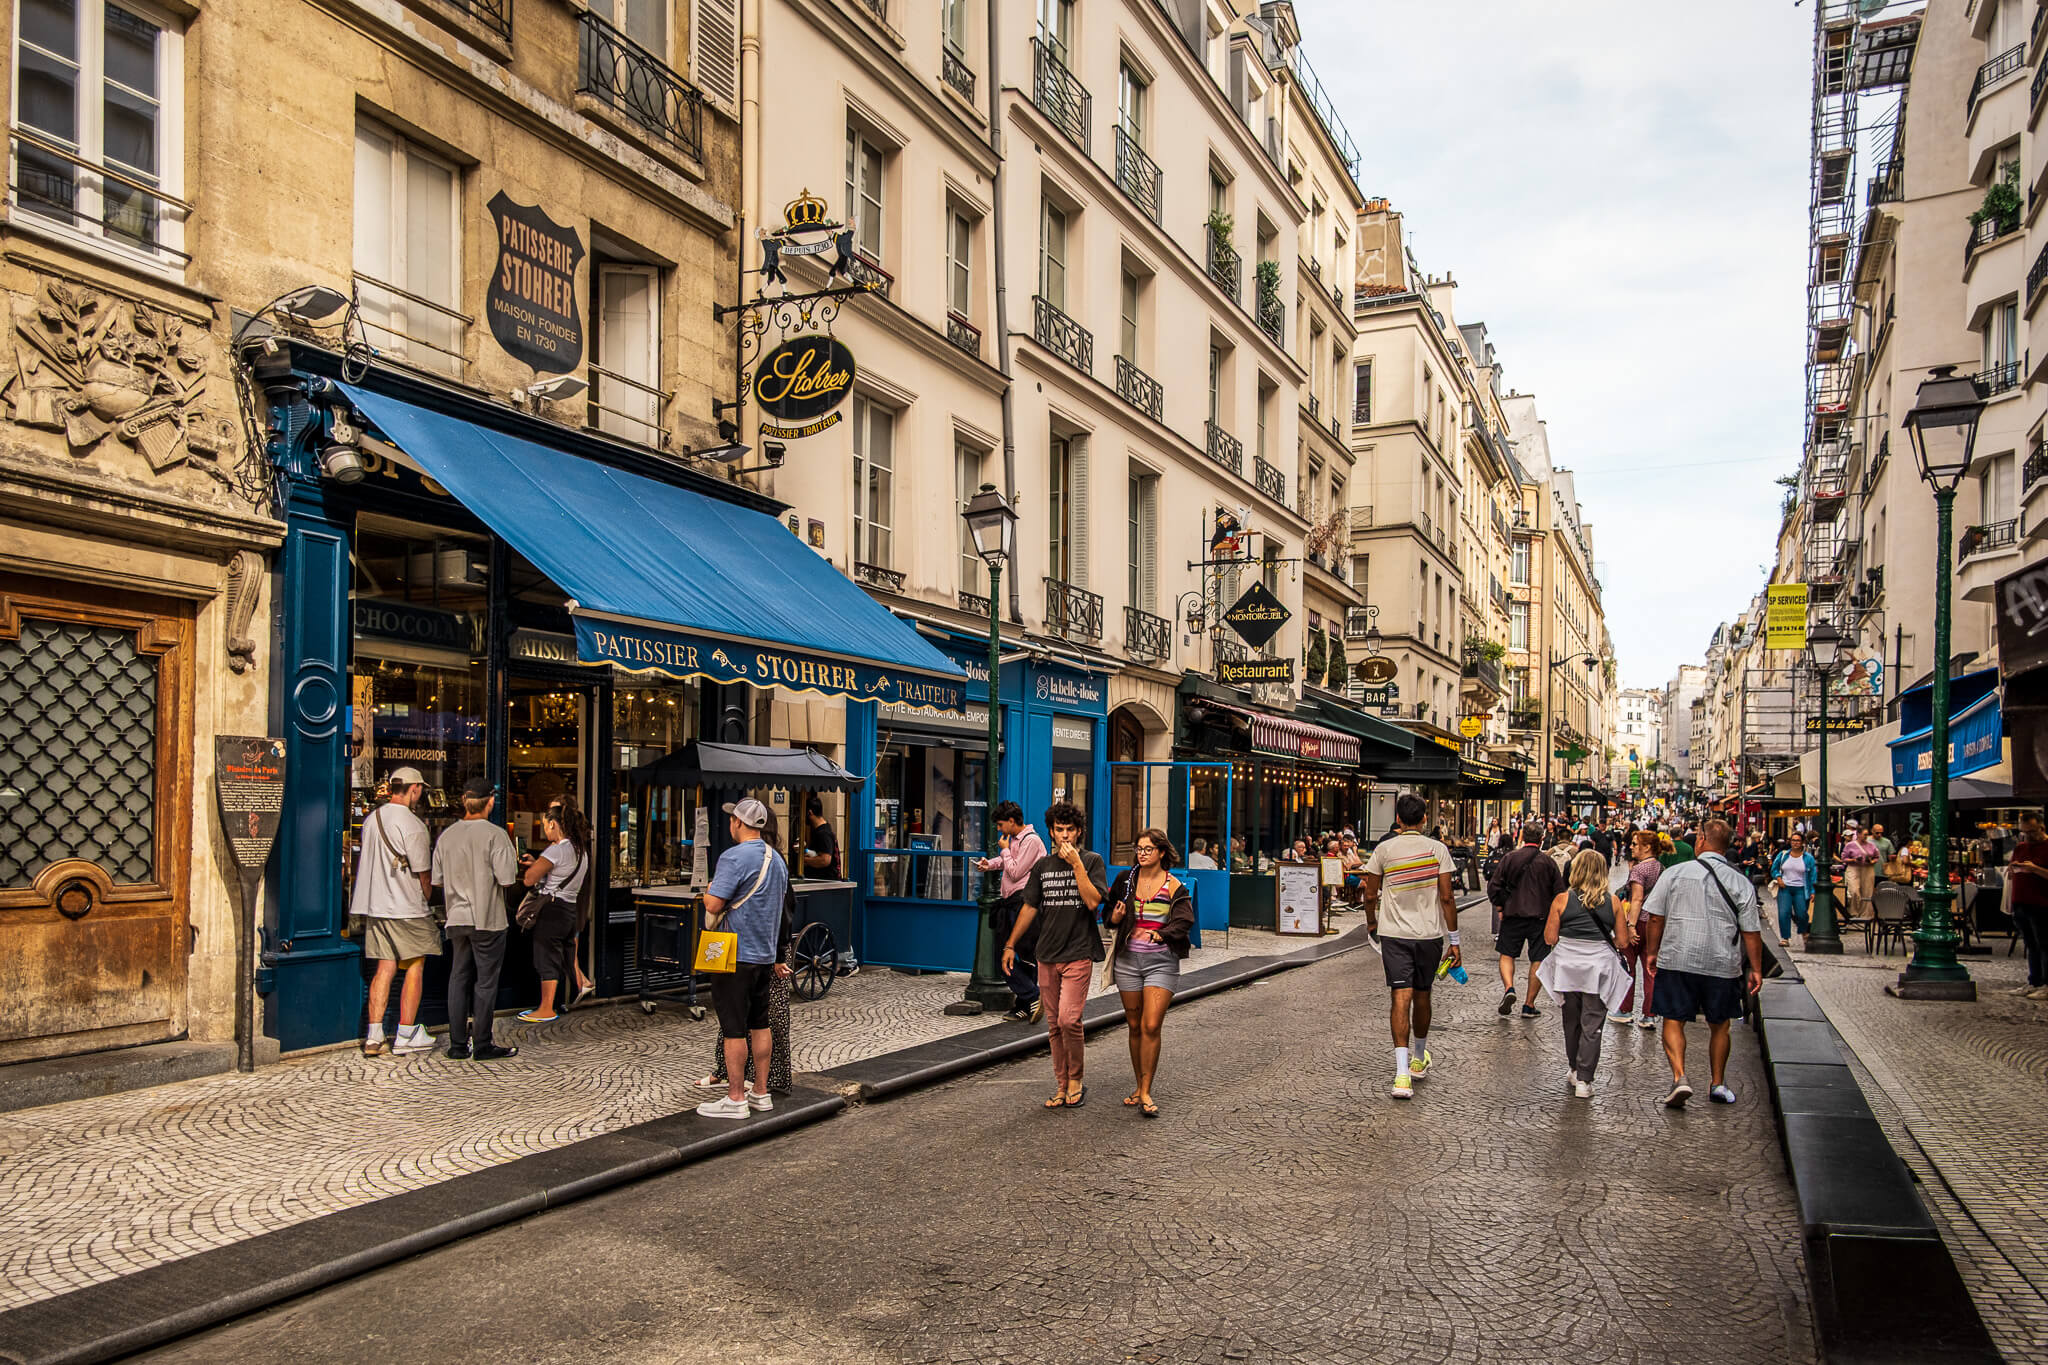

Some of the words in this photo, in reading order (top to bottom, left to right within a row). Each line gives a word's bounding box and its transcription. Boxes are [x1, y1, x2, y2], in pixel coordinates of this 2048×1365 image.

[502, 215, 573, 276] PATISSERIE
[784, 246, 811, 255] DEPUIS
[813, 241, 830, 252] 1730
[502, 252, 572, 319] STOHRER
[494, 298, 535, 326] MAISON
[538, 317, 577, 344] FONDEE
[517, 325, 531, 341] EN
[535, 333, 556, 352] 1730
[757, 348, 850, 402] Stohrer
[761, 424, 799, 440] PATISSIER
[803, 415, 838, 437] TRAITEUR
[1777, 595, 1806, 605] SERVICES
[355, 606, 458, 643] CHOCOLA
[593, 631, 700, 669] PATISSIER
[756, 653, 858, 691] STOHRER
[896, 680, 958, 706] TRAITEUR
[1222, 663, 1290, 681] Restaurant
[1050, 677, 1058, 694] la
[1058, 678, 1100, 702] belle-iloise
[1366, 692, 1386, 703] BAR
[966, 711, 989, 724] EMPOR
[1052, 727, 1069, 739] VENTE
[1069, 729, 1090, 741] DIRECTE
